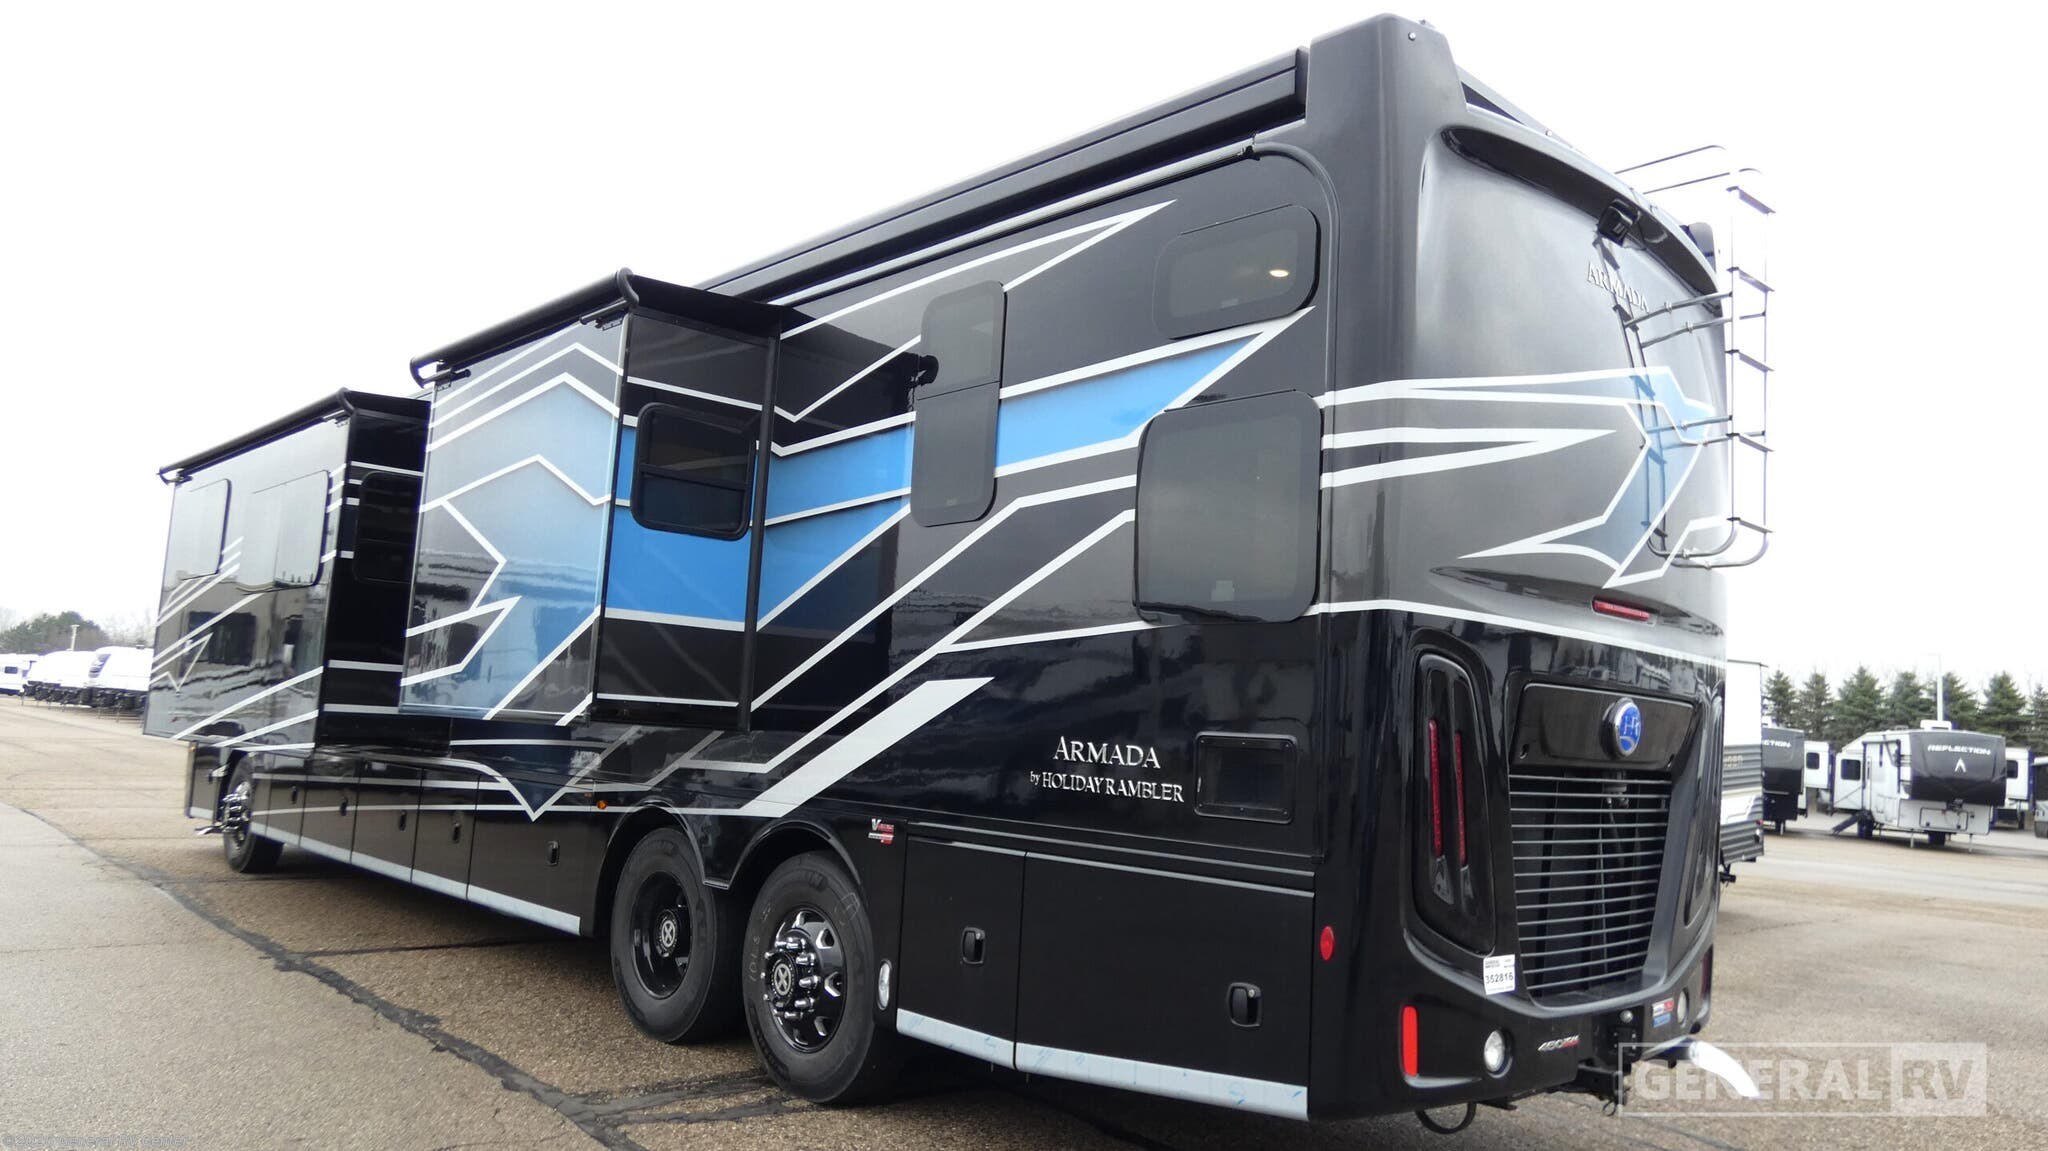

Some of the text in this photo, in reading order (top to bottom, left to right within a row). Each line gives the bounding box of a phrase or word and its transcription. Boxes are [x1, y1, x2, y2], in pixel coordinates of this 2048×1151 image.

[1053, 735, 1161, 769] ARMADA
[1927, 744, 1991, 755] REFLECTION
[1030, 771, 1184, 802] by HOLIDAY RAMBLER
[1485, 971, 1514, 984] 352816
